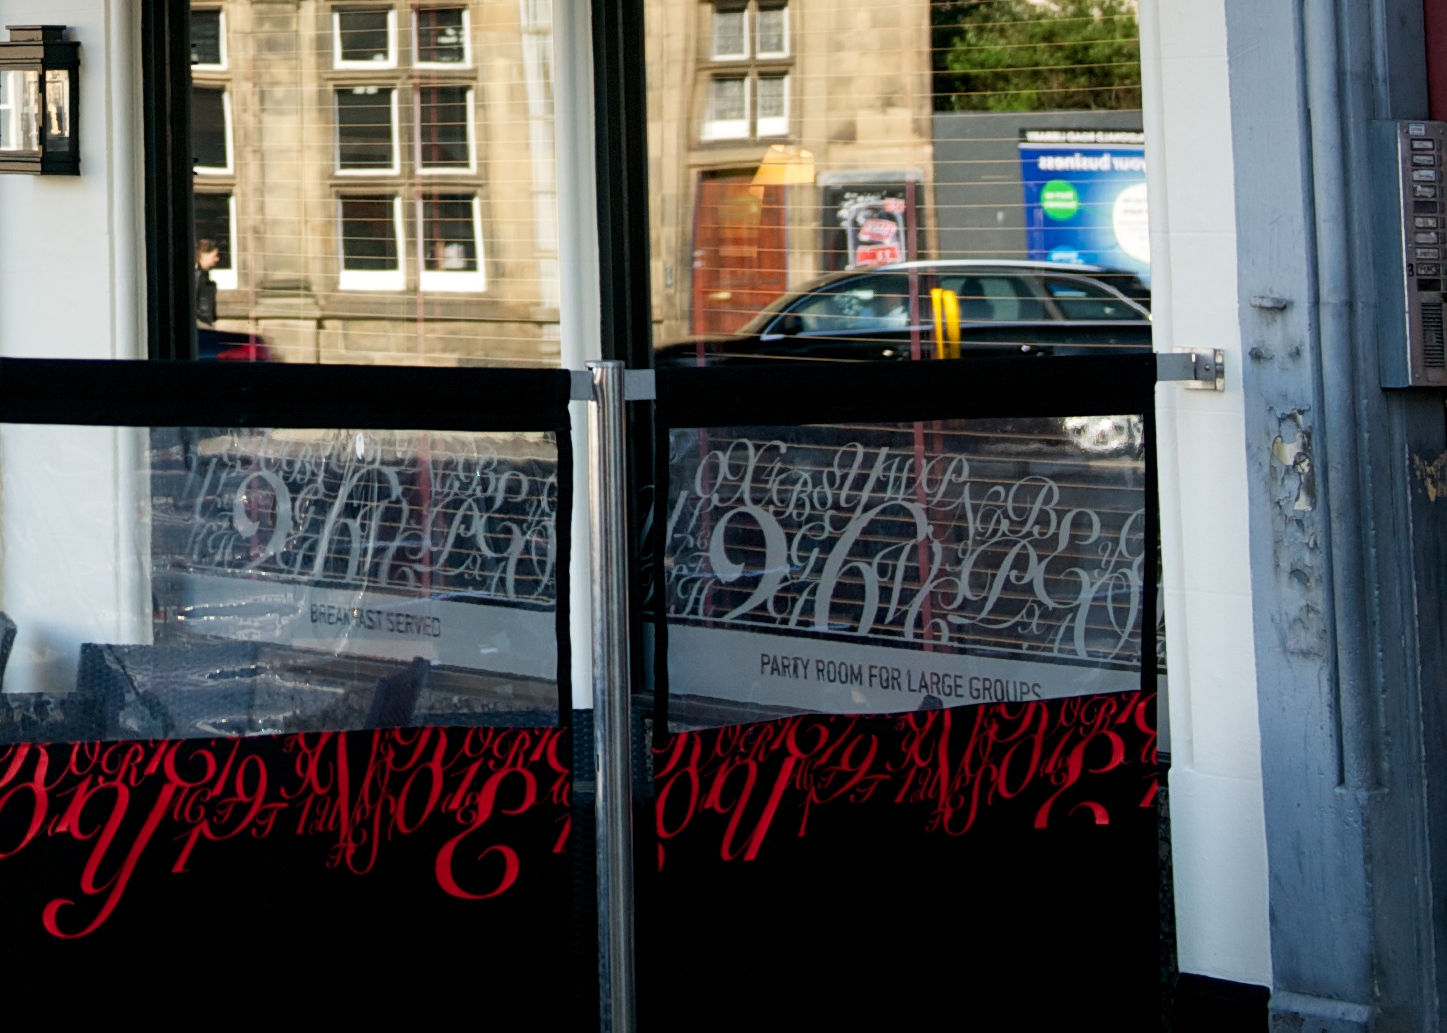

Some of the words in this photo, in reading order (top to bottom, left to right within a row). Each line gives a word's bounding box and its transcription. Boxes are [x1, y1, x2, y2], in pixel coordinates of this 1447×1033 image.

[385, 612, 441, 638] SERVED
[760, 653, 810, 680] PARTY
[815, 659, 863, 686] ROOM
[868, 665, 903, 692] FOR
[906, 669, 964, 698] LARGE
[968, 675, 1042, 702] GROUPS
